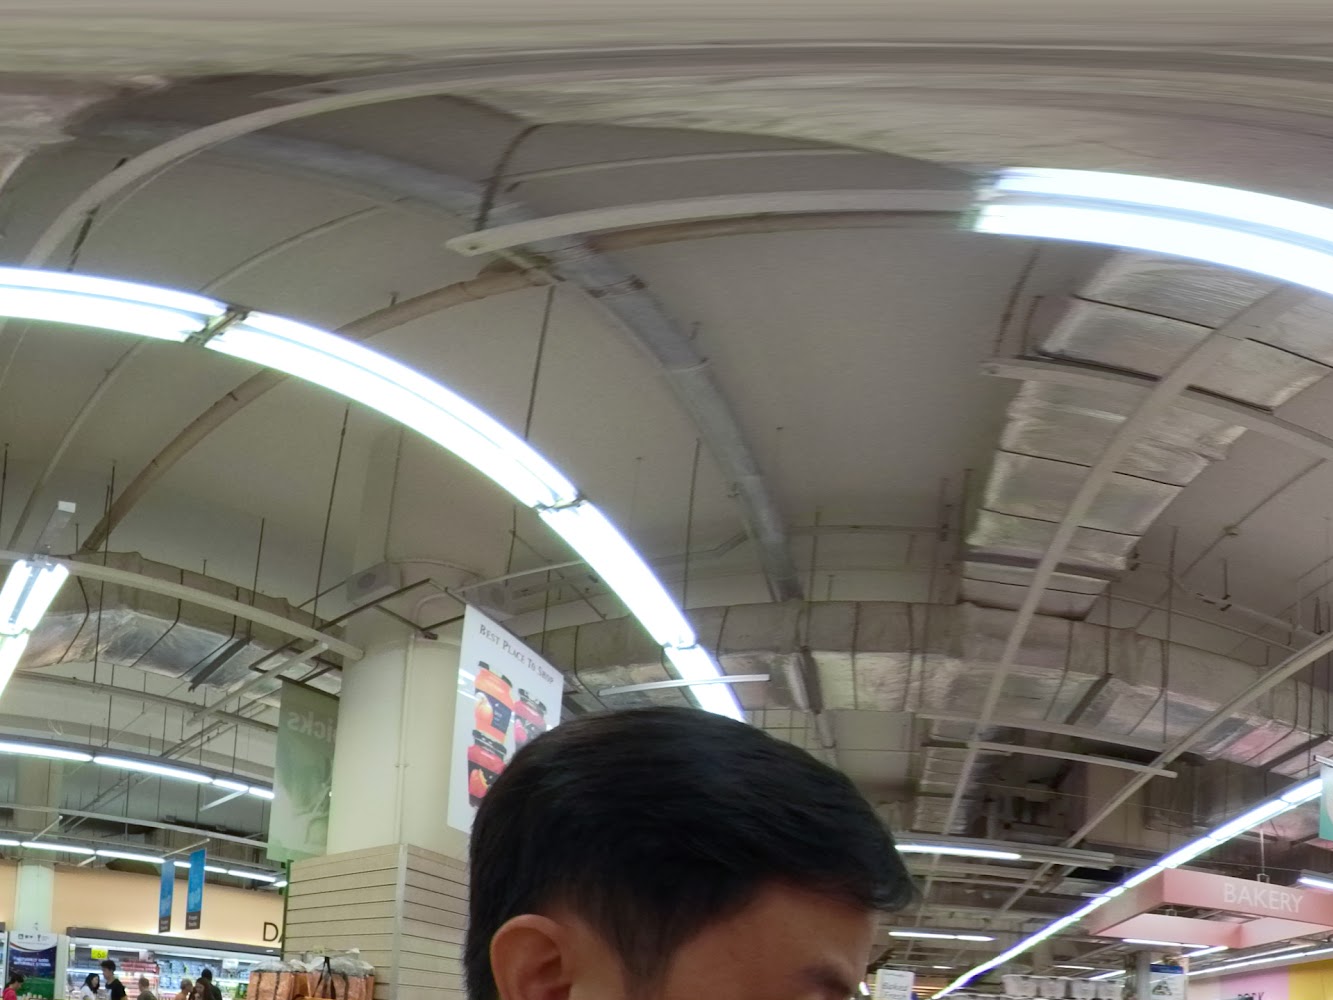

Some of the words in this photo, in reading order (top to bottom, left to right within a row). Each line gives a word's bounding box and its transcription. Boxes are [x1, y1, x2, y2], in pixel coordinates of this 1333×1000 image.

[479, 624, 500, 645] BEST
[502, 640, 525, 665] PLACE
[1222, 883, 1303, 913] BAKERY
